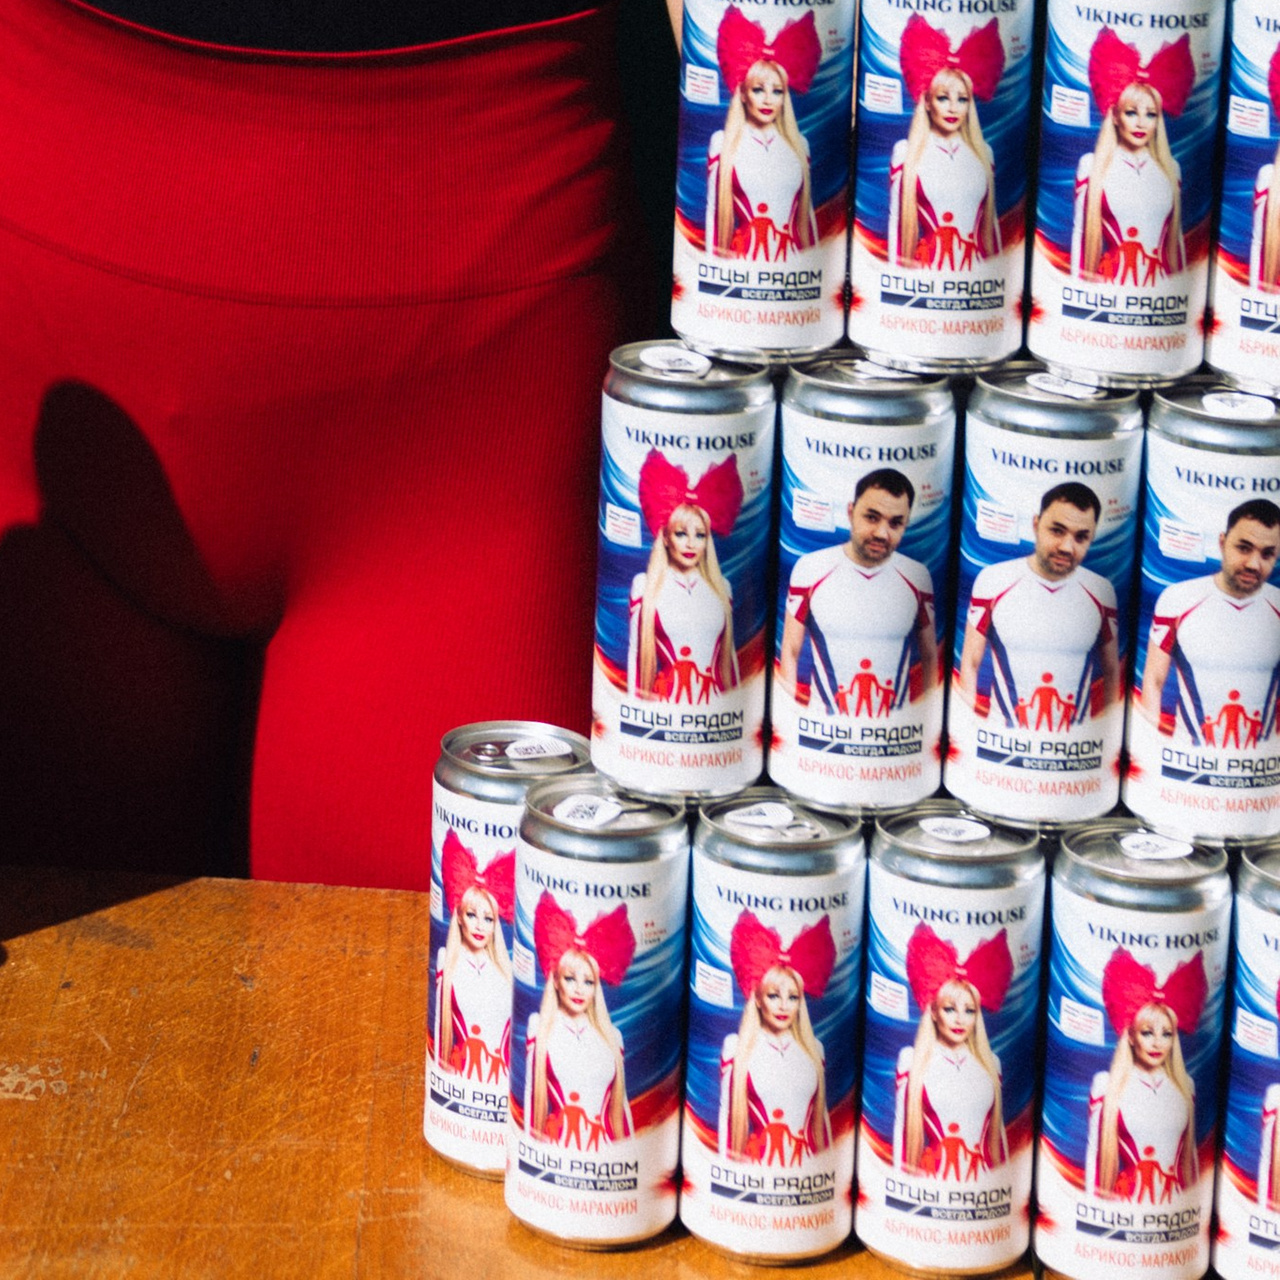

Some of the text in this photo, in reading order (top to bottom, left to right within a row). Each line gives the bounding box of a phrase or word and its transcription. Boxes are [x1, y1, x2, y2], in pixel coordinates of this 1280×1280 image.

[1076, 5, 1210, 29] VIKING HOUSE
[698, 263, 822, 287] ОТЦЫ РЯДОМ
[880, 274, 1004, 297] ОТЦЫ РЯДОМ
[1062, 286, 1187, 313] ОТЦЫ РЯДОМ
[625, 426, 757, 449] VIKING HOUSE
[806, 437, 937, 461] VIKING HOUSE
[991, 448, 1125, 474] VIKING HOUSE
[1176, 467, 1245, 490] VIKING
[620, 705, 743, 730] ОТЦЫ РЯДОМ
[799, 717, 923, 743] ОТЦЫ РЯДОМ
[977, 729, 1103, 757] ОТЦЫ РЯДОМ
[1162, 748, 1217, 771] ОТЦЫ
[434, 802, 478, 834] VIKING
[525, 863, 651, 899] VIKING HOUSE
[716, 885, 848, 913] VIKING HOUSE
[892, 897, 1026, 925] VIKING HOUSE
[1087, 921, 1220, 948] VIKING HOUSE
[429, 1074, 464, 1102] ОТЦЫ
[519, 1142, 638, 1181] ОТЦЫ РЯДОМ
[710, 1164, 835, 1192] ОТЦЫ РЯДОМ
[886, 1178, 1011, 1207] ОТЦЫ РЯДОМ
[1076, 1202, 1201, 1229] ОТЦЫ РЯДОМ
